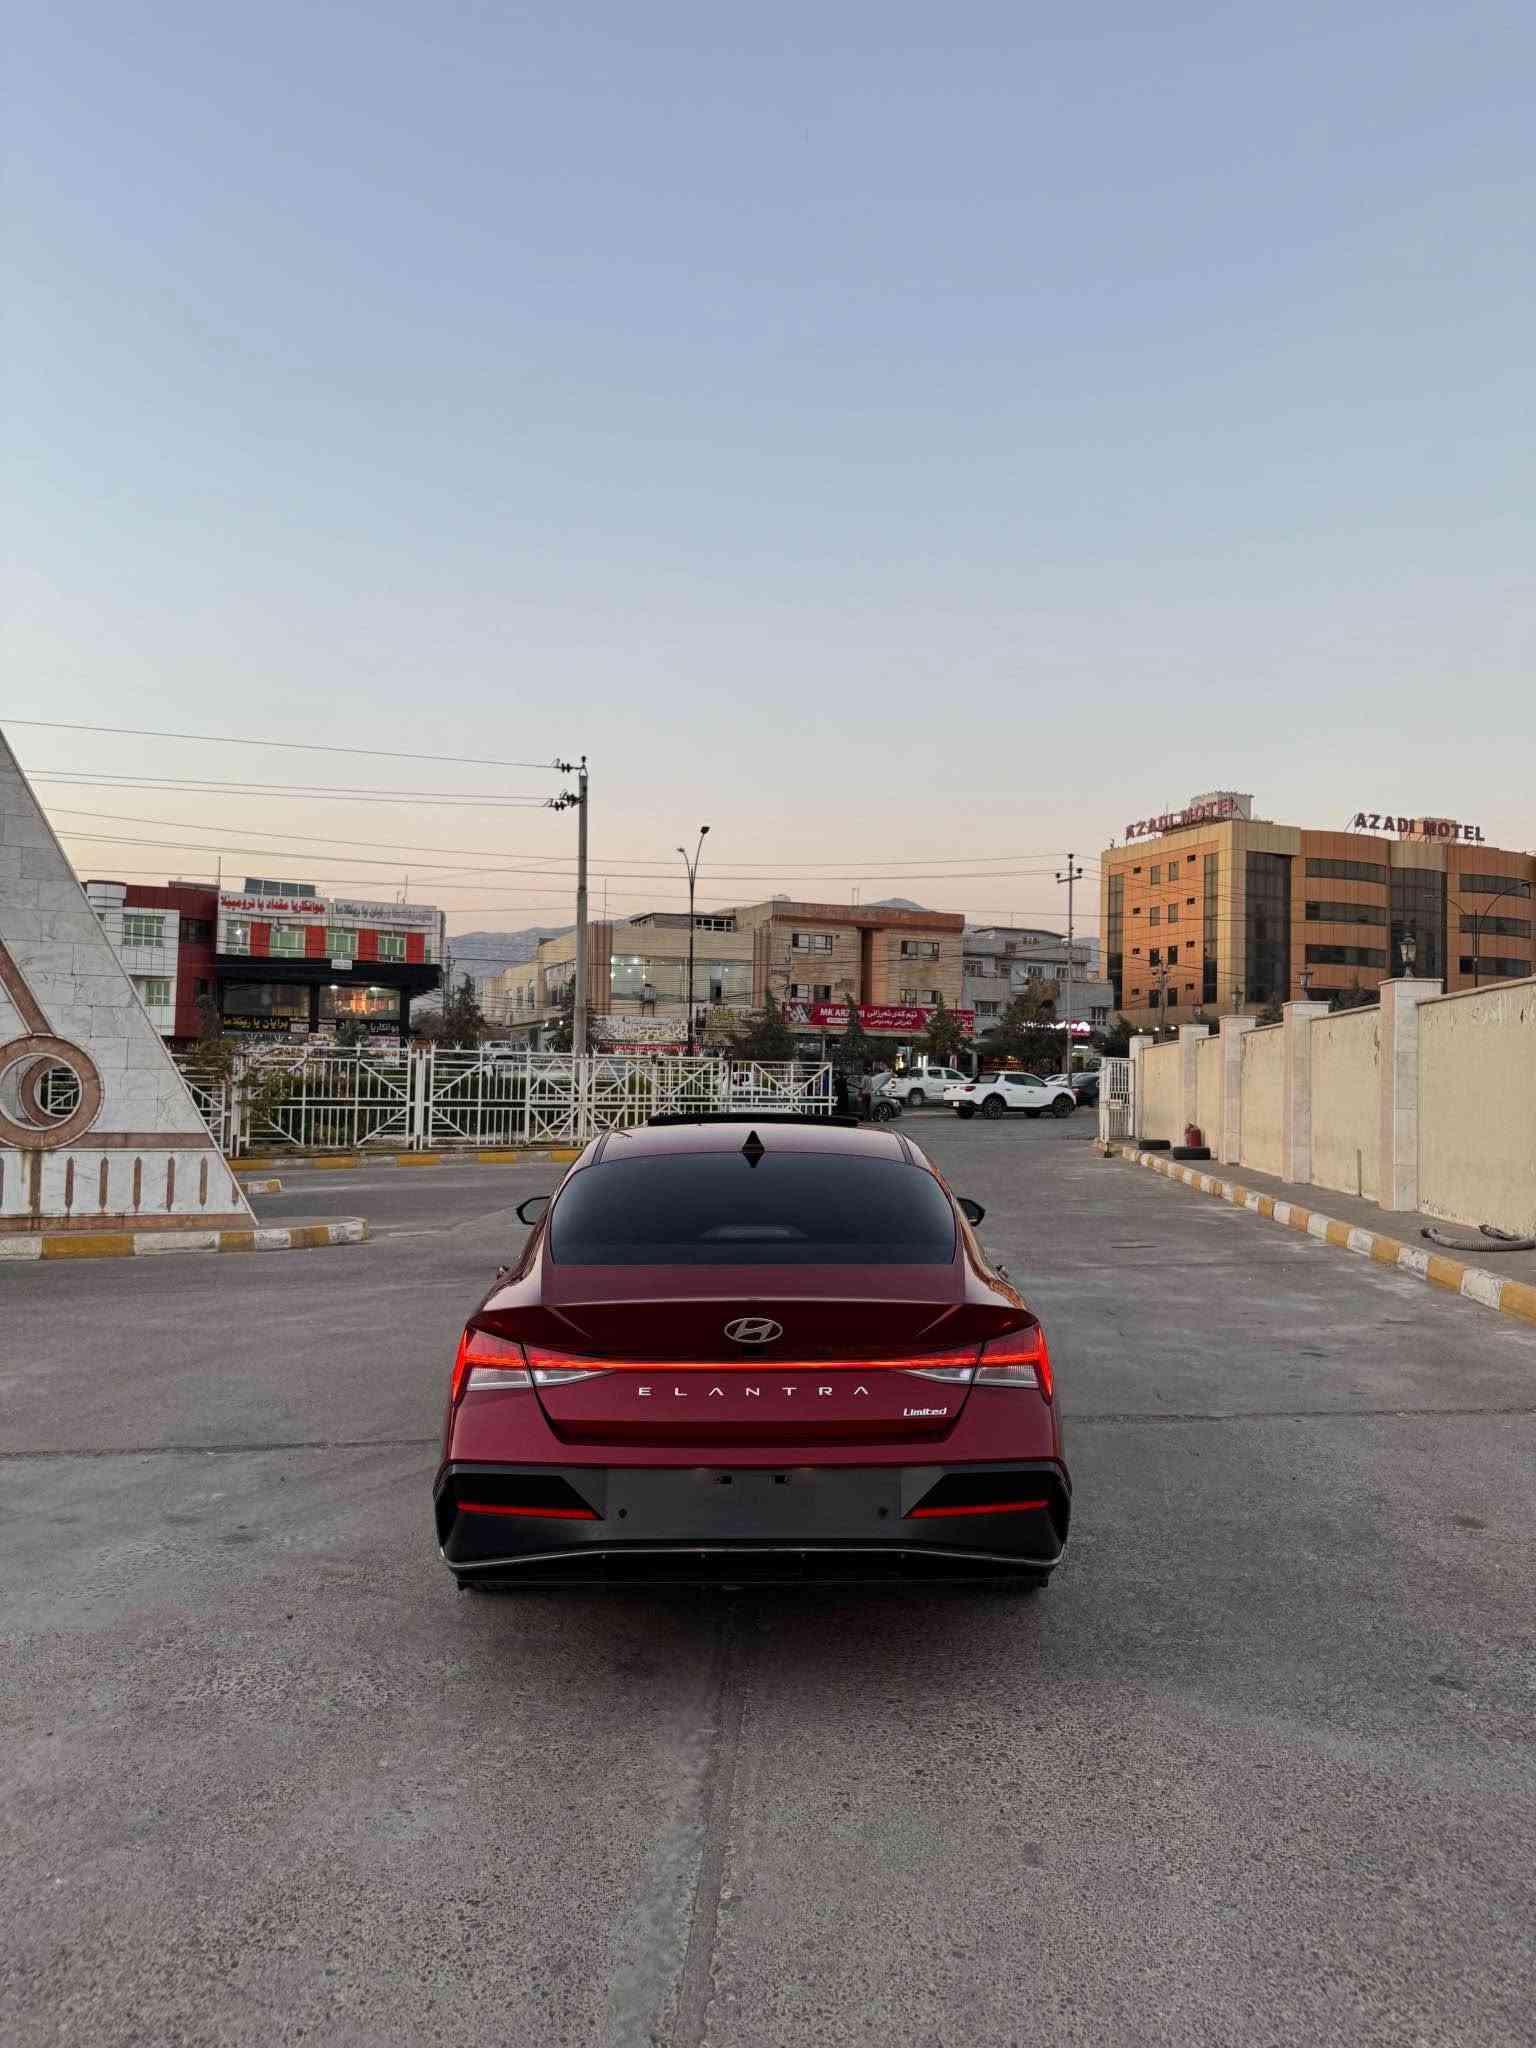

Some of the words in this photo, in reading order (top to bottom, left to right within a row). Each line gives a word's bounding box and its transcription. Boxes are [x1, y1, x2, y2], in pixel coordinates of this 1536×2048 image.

[1125, 812, 1174, 840] AZADI
[1354, 812, 1416, 833] AZADI
[638, 1386, 869, 1397] ELANTRA
[903, 1407, 947, 1417] Limited
